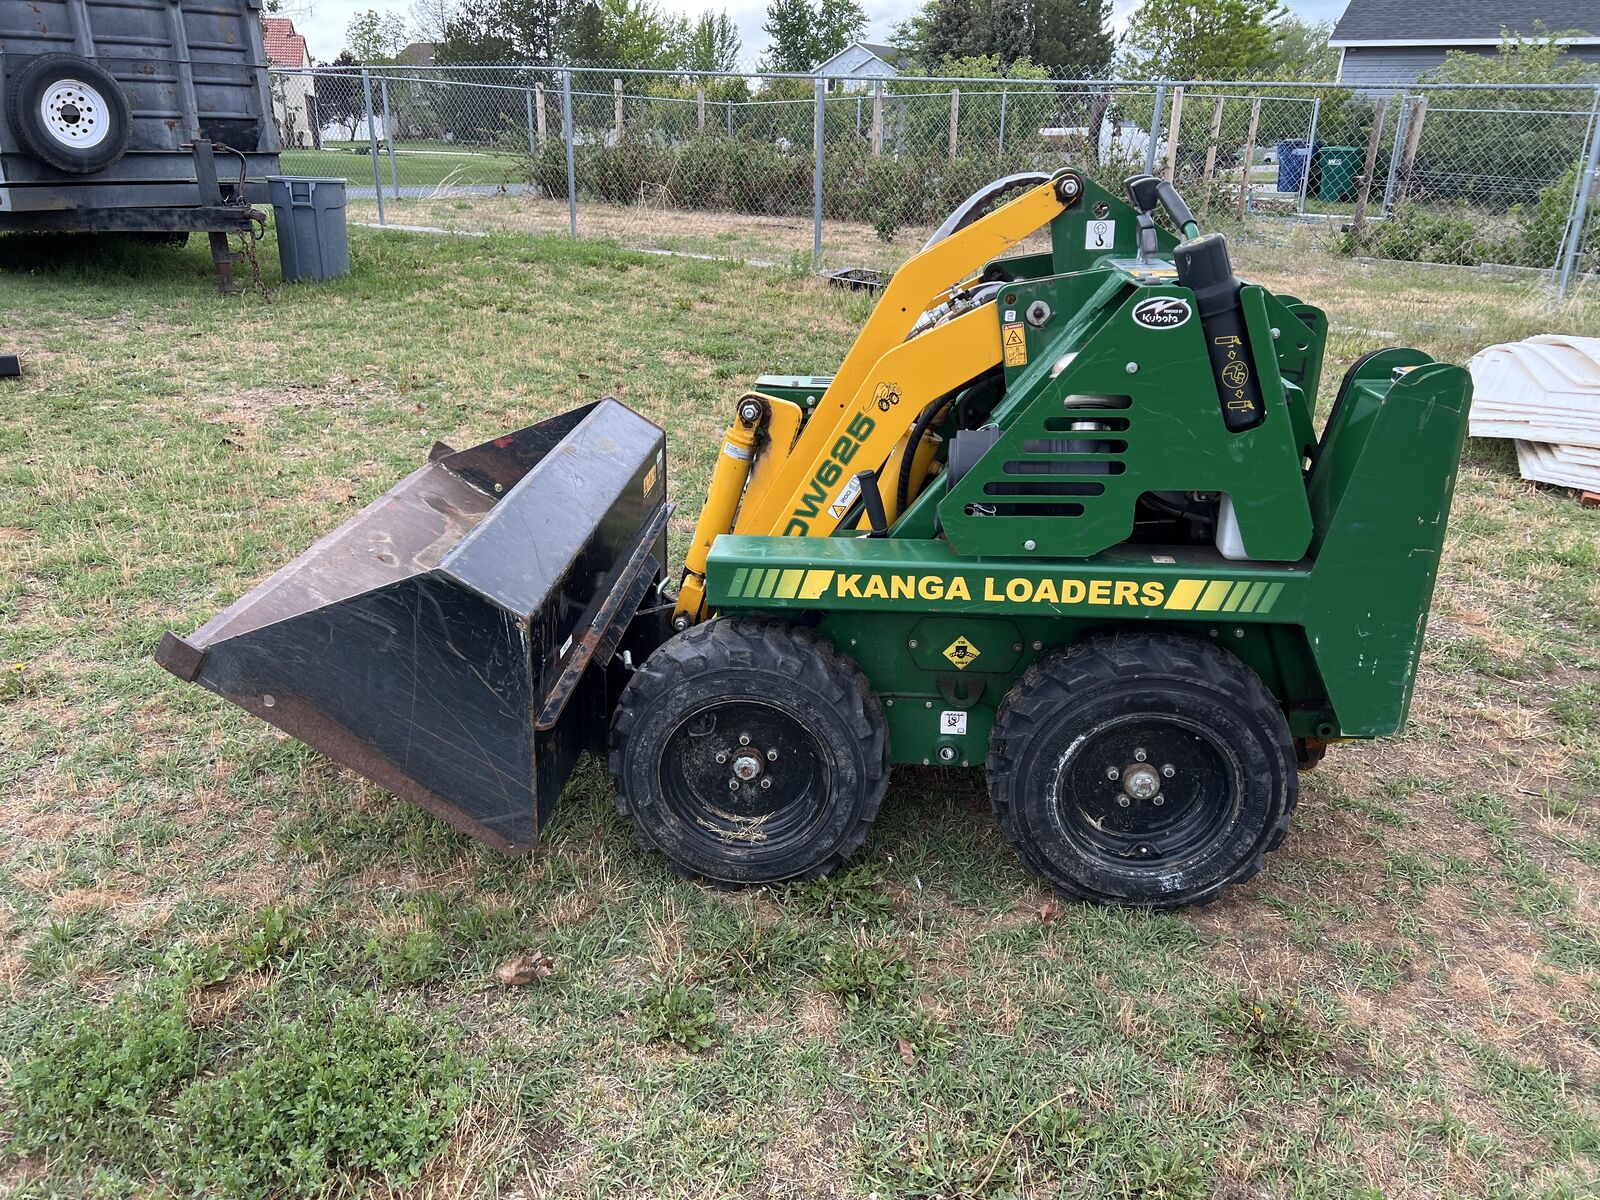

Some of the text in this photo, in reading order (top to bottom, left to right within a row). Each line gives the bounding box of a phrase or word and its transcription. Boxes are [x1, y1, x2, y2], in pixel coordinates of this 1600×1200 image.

[1142, 313, 1179, 323] Kubota
[782, 410, 877, 537] DW625
[837, 573, 1165, 606] KANGA LOADERS
